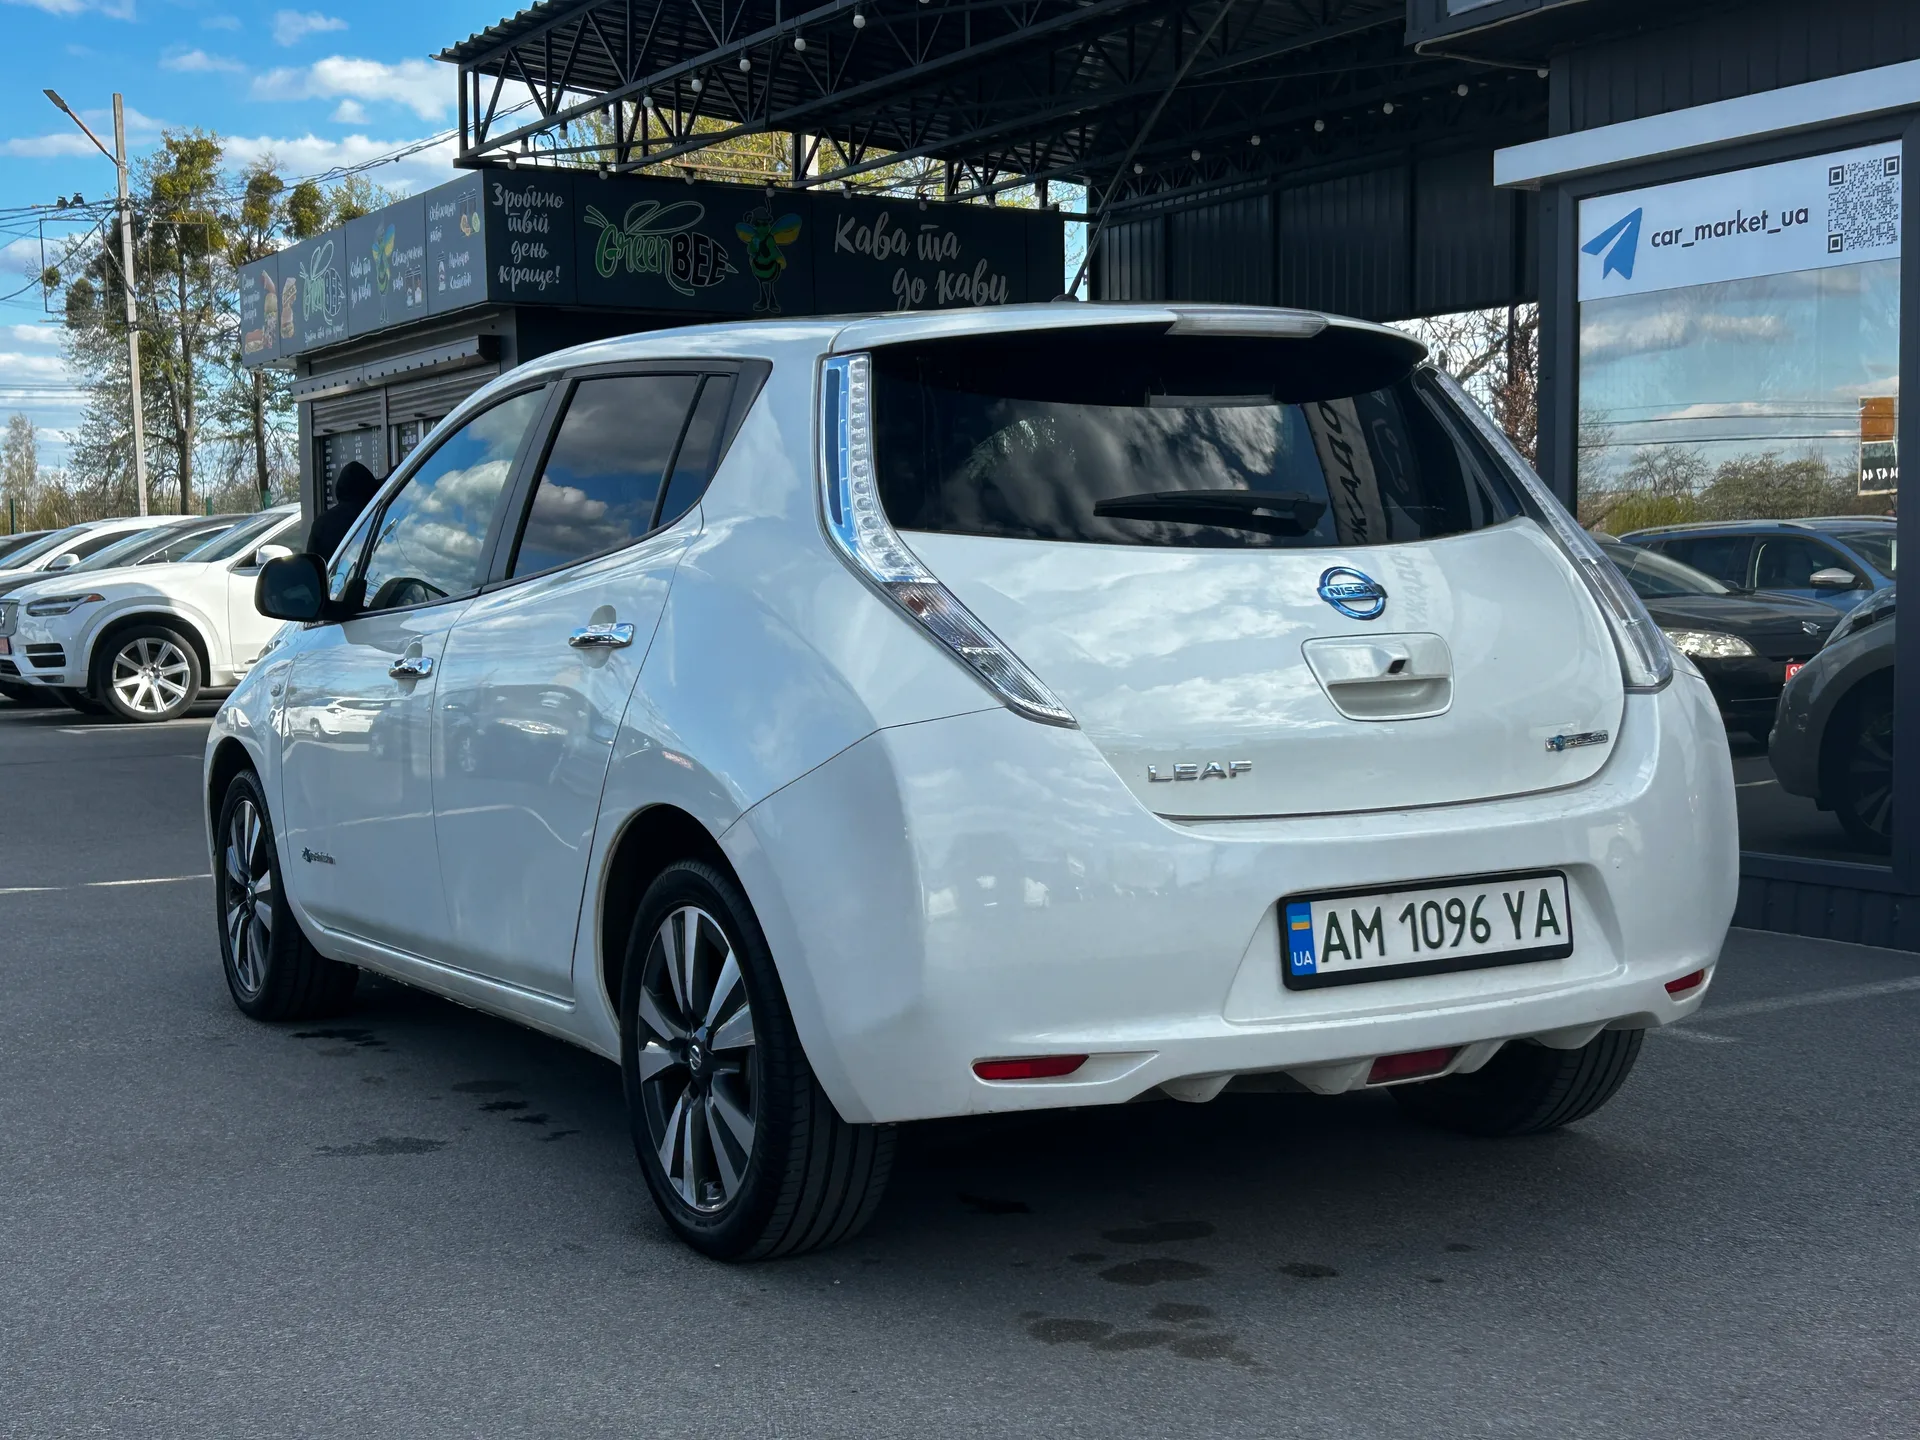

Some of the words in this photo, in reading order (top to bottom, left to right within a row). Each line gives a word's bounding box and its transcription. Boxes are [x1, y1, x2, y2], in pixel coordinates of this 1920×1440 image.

[491, 182, 565, 216] Зробимо
[507, 209, 550, 235] твій
[833, 211, 912, 261] Кава
[917, 224, 962, 262] та
[1650, 206, 1810, 249] car_market_ua
[510, 239, 550, 265] день
[497, 265, 562, 293] краще!
[892, 267, 928, 312] до
[935, 258, 1010, 307] кави
[1148, 760, 1253, 783] LEAF
[1321, 906, 1386, 963] AM
[1398, 894, 1492, 953] 1096
[1502, 888, 1562, 941] YA
[1293, 951, 1314, 968] UA
